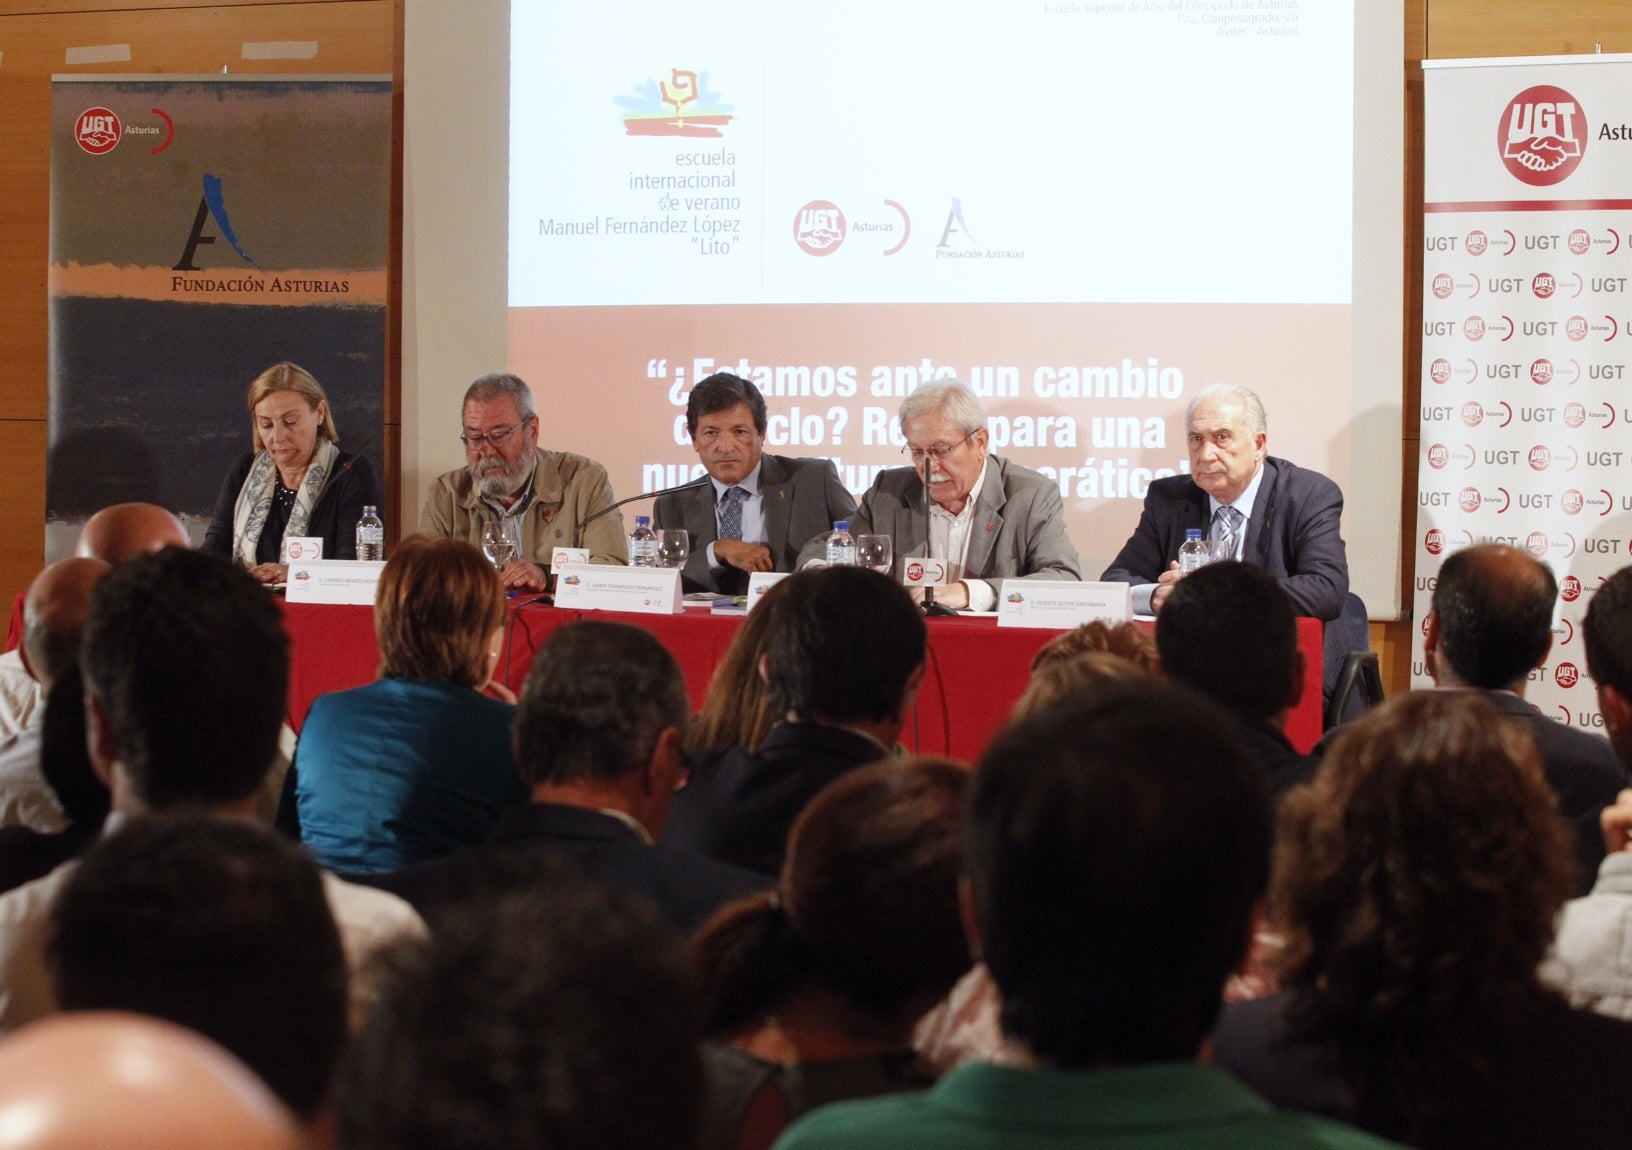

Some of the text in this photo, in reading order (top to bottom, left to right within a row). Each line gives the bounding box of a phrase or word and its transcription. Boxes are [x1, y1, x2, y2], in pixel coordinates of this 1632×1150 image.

[1143, 0, 1164, 12] Arte
[1256, 25, 1299, 36] Asturias
[81, 116, 160, 136] UGT Asturias
[1508, 102, 1576, 142] UGT
[675, 147, 736, 166] escuela
[629, 169, 736, 190] internacional
[685, 196, 741, 211] verano
[538, 214, 741, 236] Manuel Fernández López
[800, 208, 894, 232] UGT Asturias
[1427, 237, 1457, 251] UGT
[1525, 236, 1560, 249] UGT
[1489, 279, 1523, 292] UGT
[1592, 278, 1627, 292] UGT
[1424, 322, 1455, 336] UGT
[1523, 322, 1557, 335] UGT
[971, 366, 1019, 398] un
[1033, 358, 1183, 399] cambio
[1487, 365, 1521, 378] UGT
[1589, 365, 1625, 379] UGT
[1423, 407, 1453, 420] UGT
[1521, 408, 1555, 422] UGT
[764, 406, 849, 446] clo?
[988, 415, 1077, 455] para
[1091, 416, 1166, 449] una
[1485, 451, 1519, 464] UGT
[1587, 452, 1623, 466] UGT
[1420, 492, 1450, 506] UGT
[1519, 495, 1553, 508] UGT
[1584, 540, 1620, 553] UGT
[1417, 577, 1437, 591] UG
[1561, 580, 1577, 592] UGT
[1527, 668, 1547, 681] GT
[1557, 666, 1576, 678] UGT
[1579, 713, 1603, 727] UG
